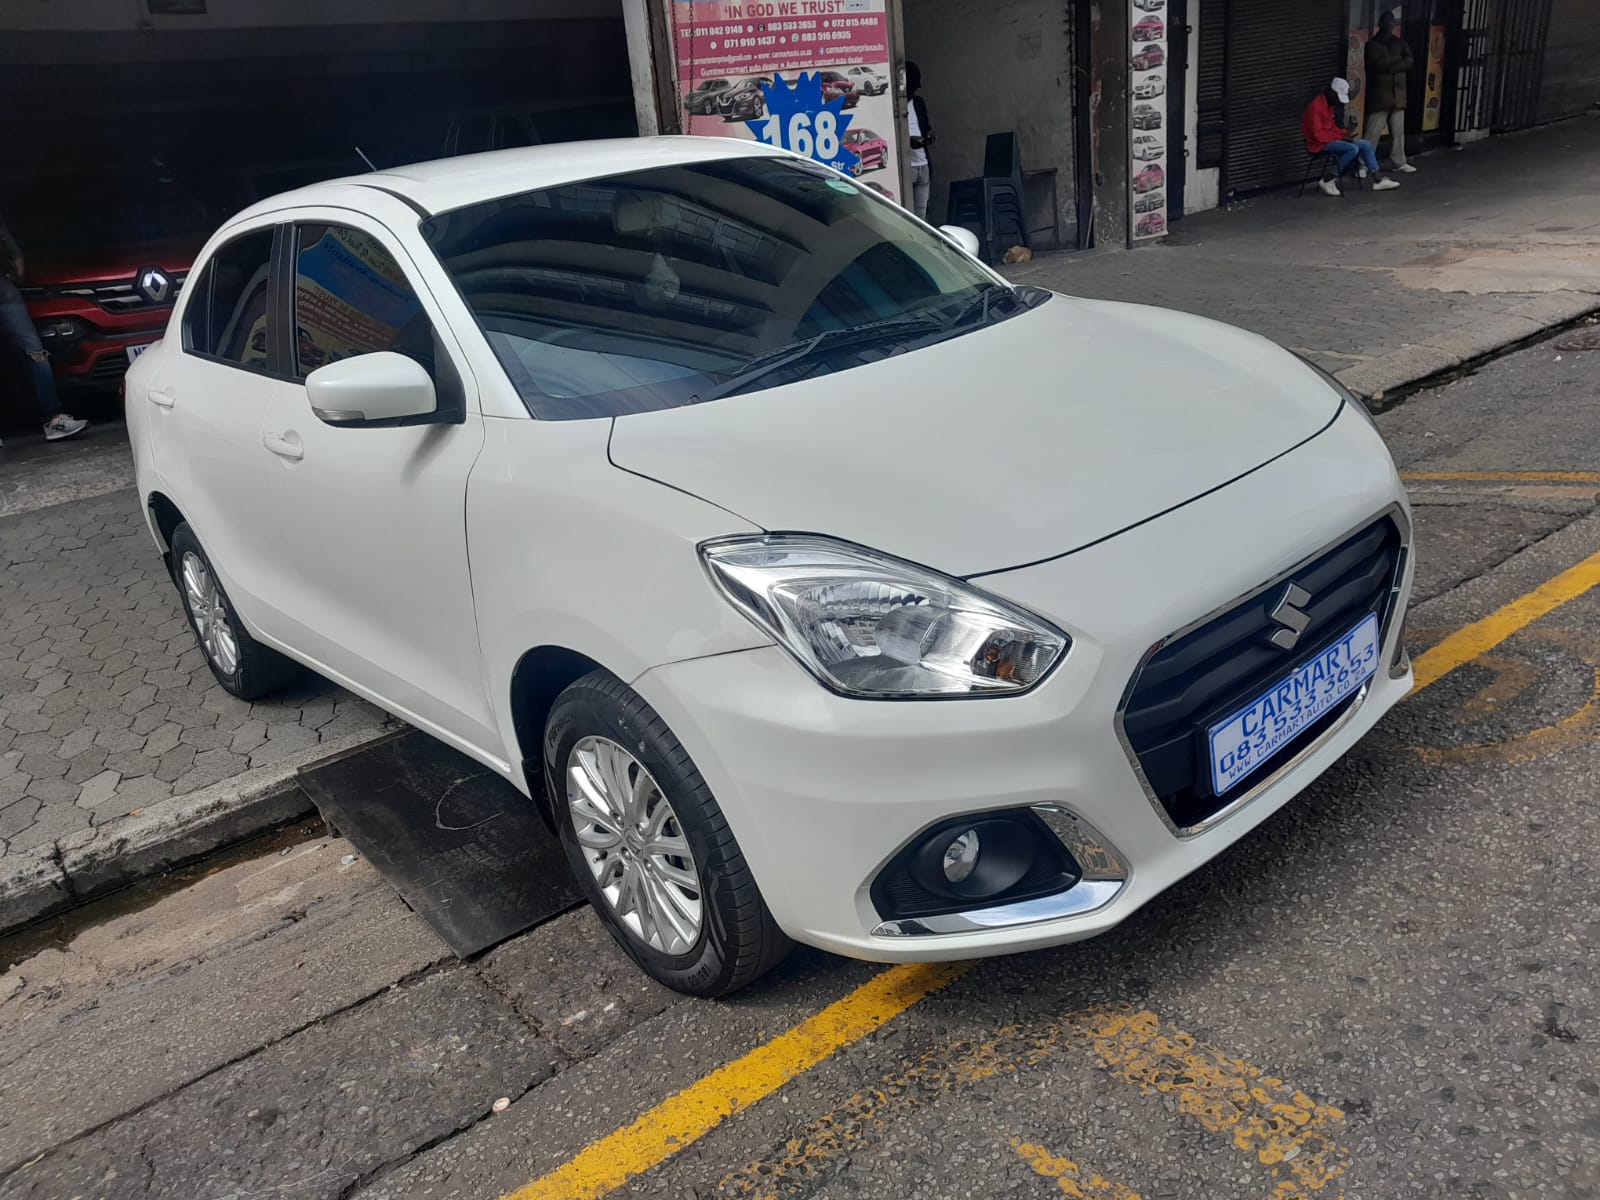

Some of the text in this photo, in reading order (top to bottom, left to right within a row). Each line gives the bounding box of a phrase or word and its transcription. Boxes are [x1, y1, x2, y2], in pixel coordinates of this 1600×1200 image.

[747, 4, 774, 17] GOD
[778, 2, 797, 15] WE
[709, 26, 724, 36] 042
[725, 25, 743, 35] 9148
[768, 23, 782, 32] 083
[783, 21, 797, 31] 533
[798, 20, 816, 30] 3653
[832, 19, 845, 28] 072
[846, 18, 859, 27] 015
[860, 17, 878, 27] 4488
[724, 31, 851, 49] 071 910 1437 083 516 0935
[762, 63, 779, 71] dealer
[835, 57, 847, 65] auto
[848, 56, 864, 64] dealer
[763, 111, 839, 160] 168
[1242, 635, 1355, 737] CARMART
[1220, 643, 1374, 774] 083 533 3653
